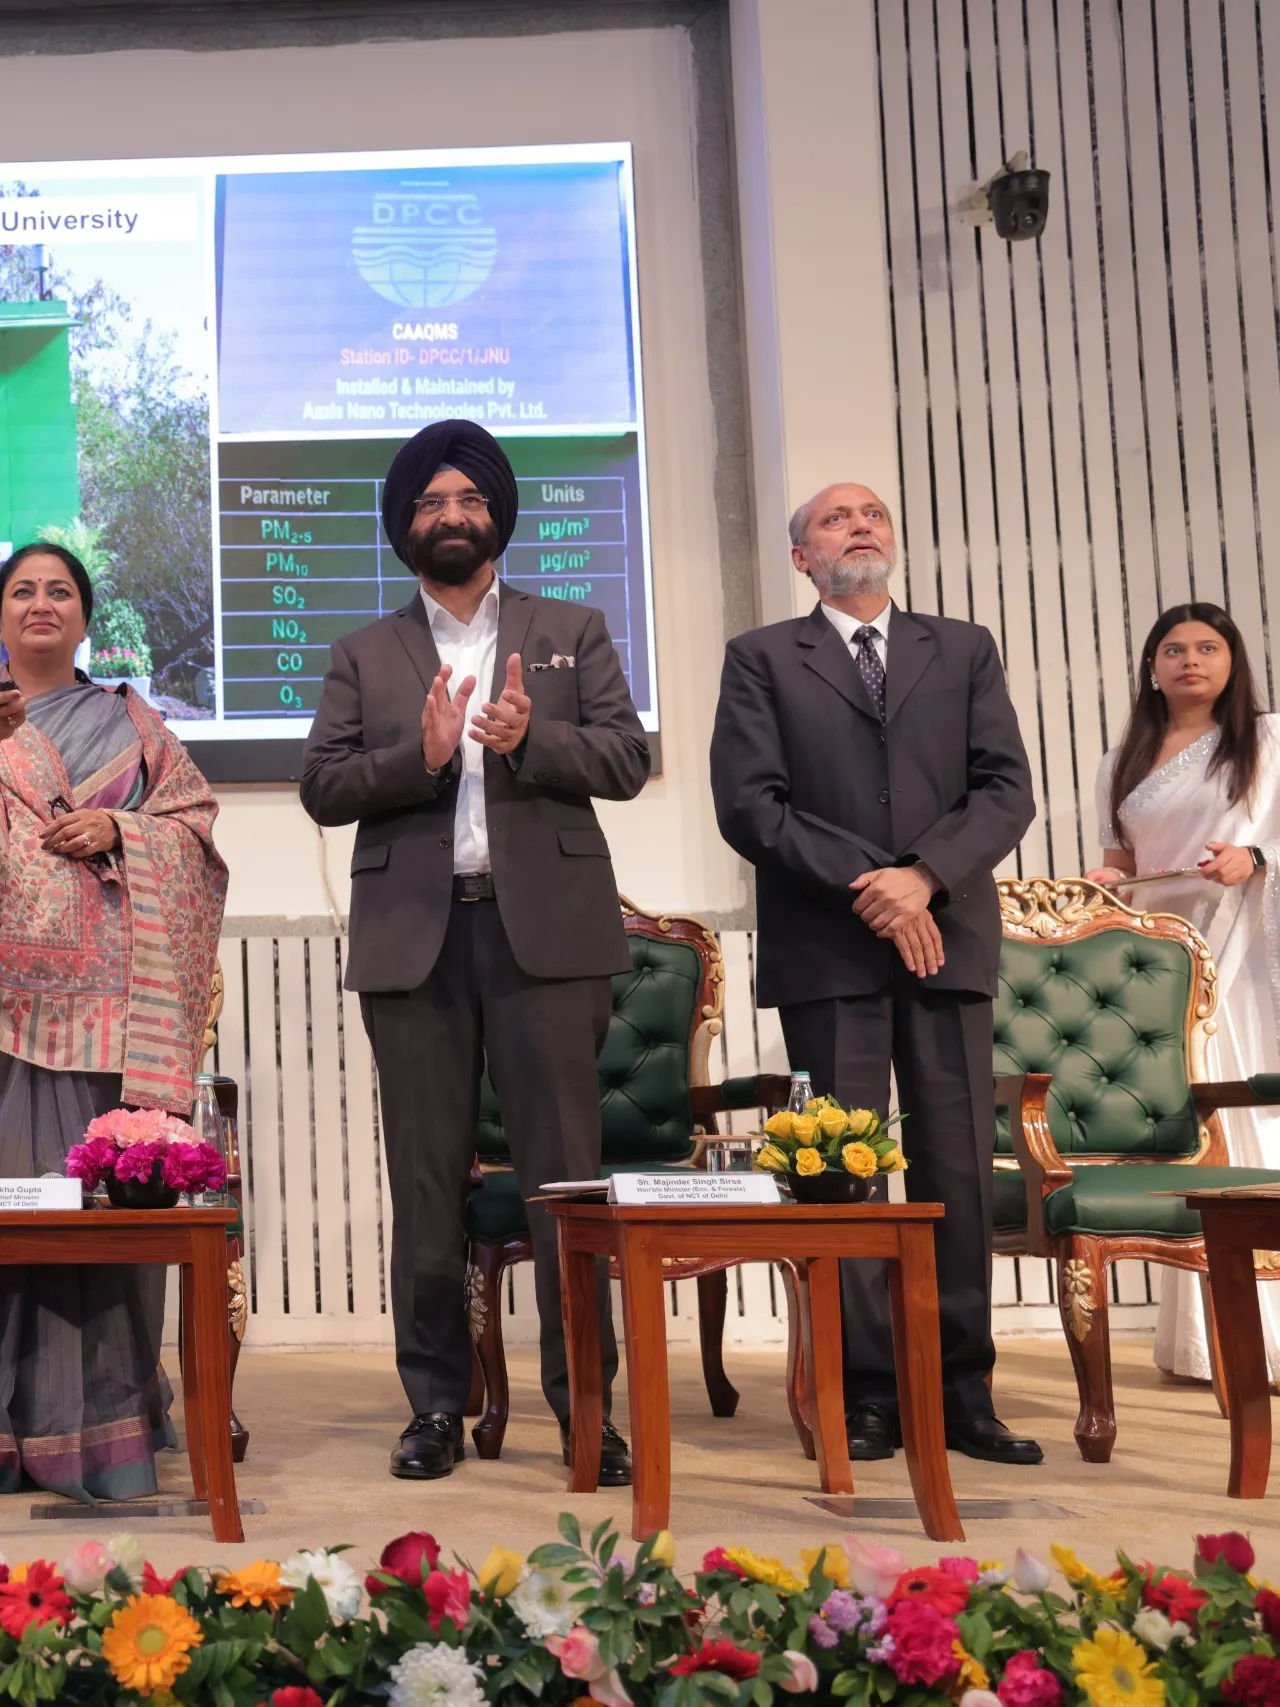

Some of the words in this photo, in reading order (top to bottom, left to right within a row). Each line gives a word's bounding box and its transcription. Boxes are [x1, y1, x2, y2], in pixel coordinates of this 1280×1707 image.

[1, 208, 139, 234] University
[372, 201, 483, 226] DPCC
[392, 323, 459, 341] CAAQMS
[340, 348, 391, 365] Station
[419, 348, 511, 365] DPCC/1/JNU
[336, 377, 398, 396] Installed
[401, 377, 412, 396] &
[416, 377, 495, 396] Maintained
[498, 377, 516, 398] by
[346, 401, 386, 420] Nano
[388, 401, 485, 420] Technologies
[487, 401, 517, 420] Pvt.
[520, 401, 548, 419] Ltd.
[240, 485, 330, 506] Parameter
[541, 484, 585, 503] Units
[276, 652, 303, 672] CO
[17, 1186, 42, 1194] Gupta
[637, 1178, 651, 1186] Sh.
[692, 1178, 717, 1187] Singh
